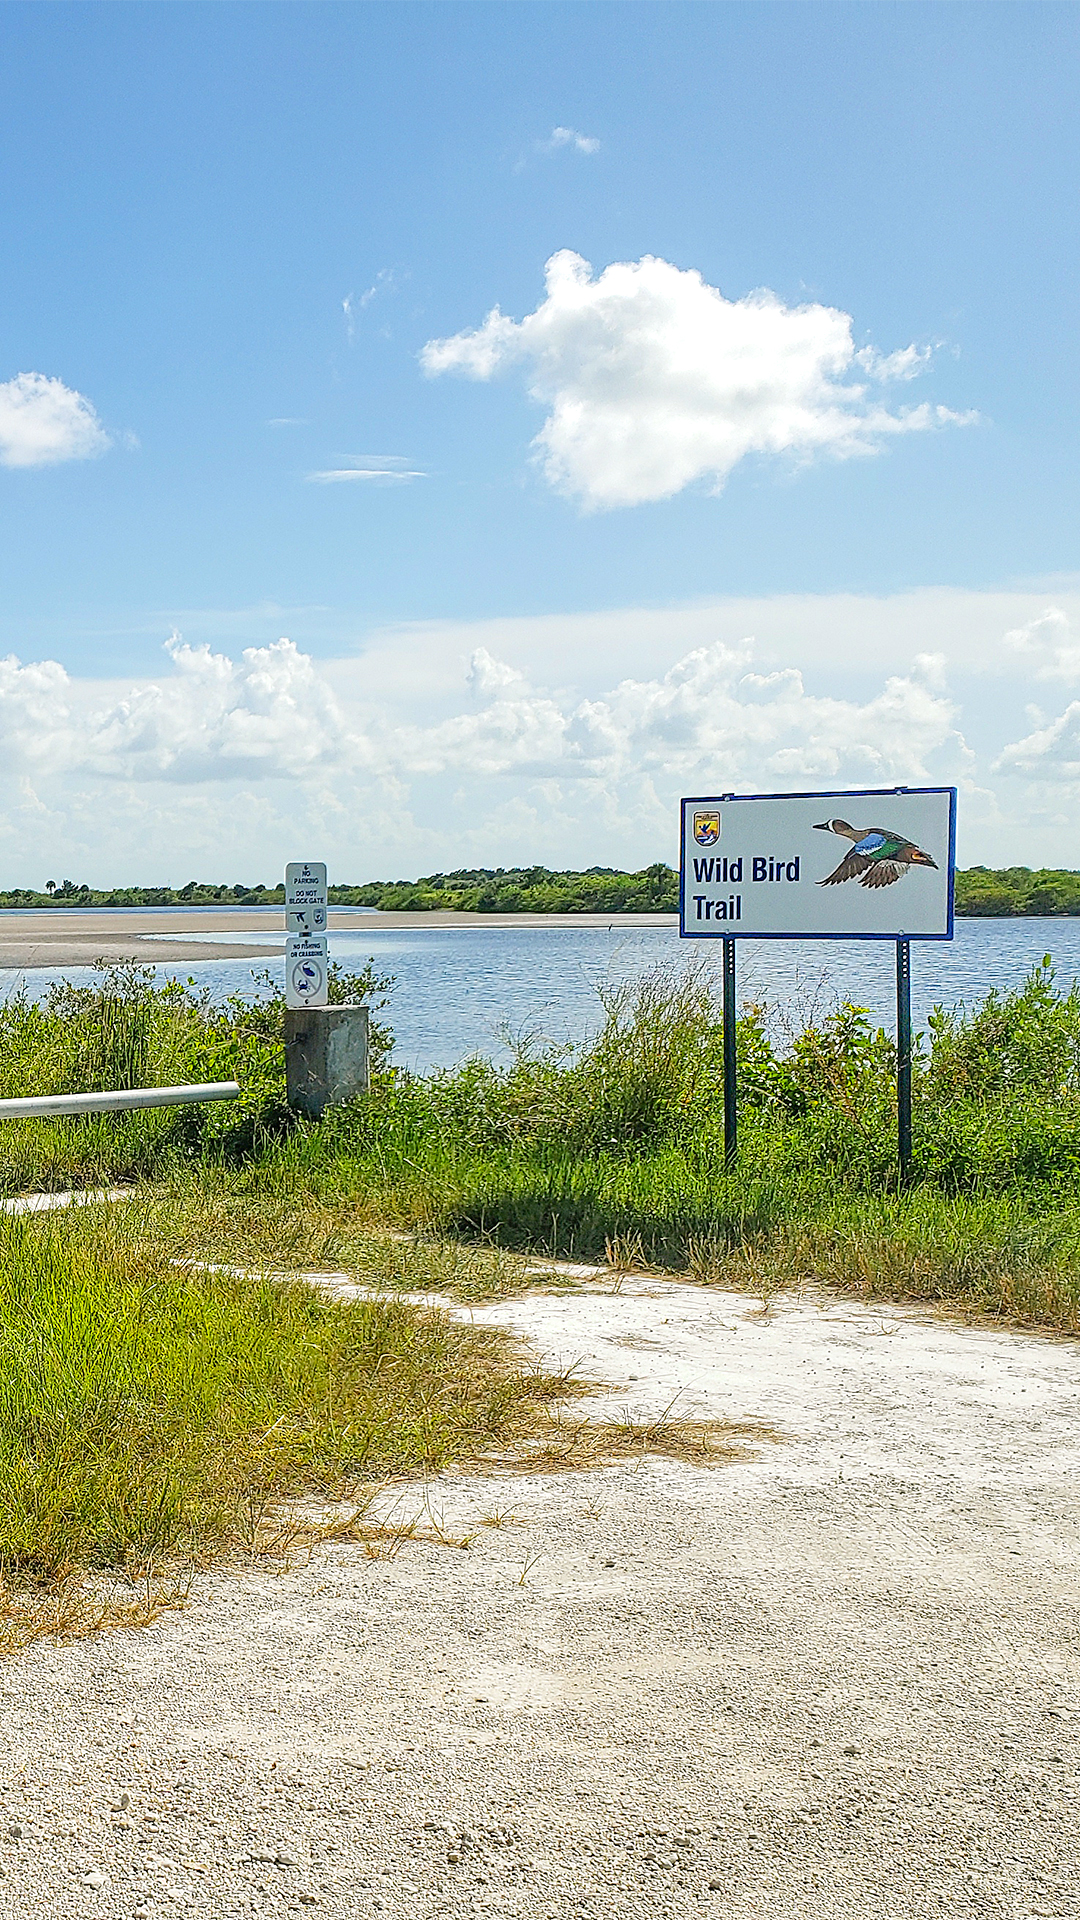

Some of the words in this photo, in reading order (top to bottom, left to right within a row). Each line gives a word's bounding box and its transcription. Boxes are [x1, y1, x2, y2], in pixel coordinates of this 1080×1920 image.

[693, 857, 743, 883] Wild
[752, 856, 800, 882] Bird
[693, 895, 742, 920] Trail
